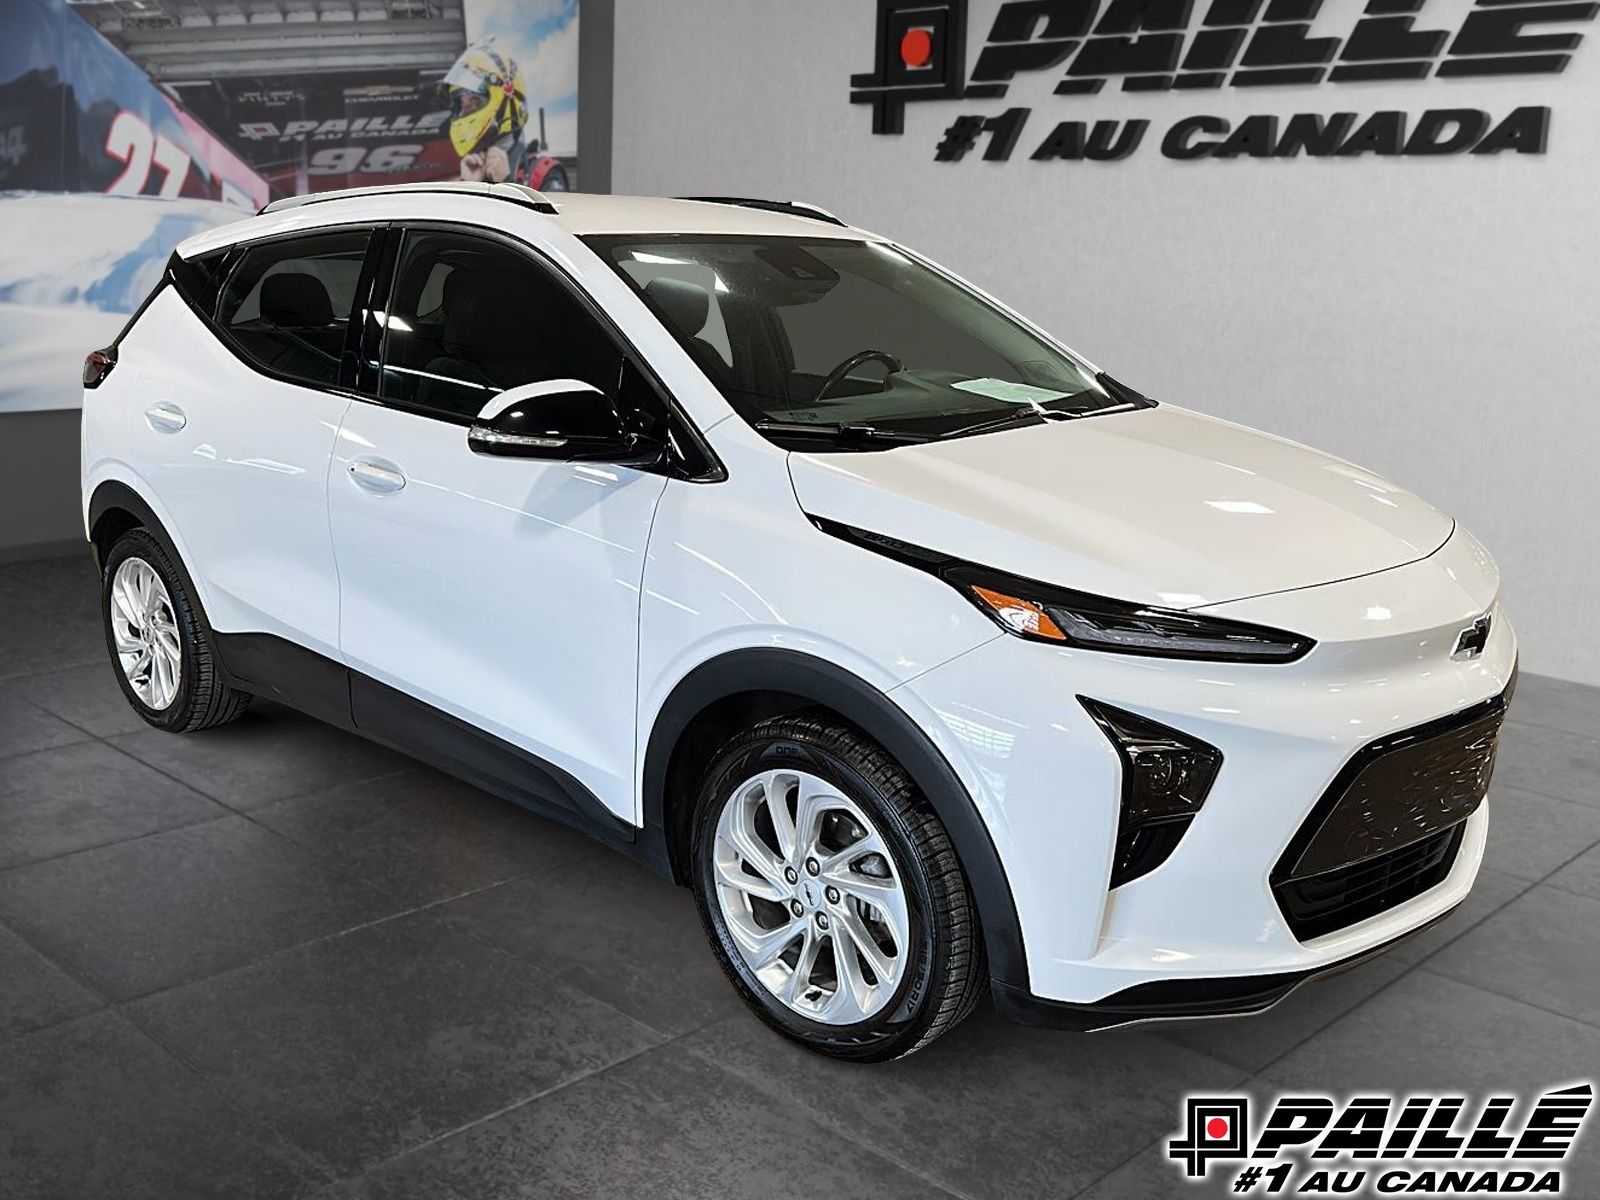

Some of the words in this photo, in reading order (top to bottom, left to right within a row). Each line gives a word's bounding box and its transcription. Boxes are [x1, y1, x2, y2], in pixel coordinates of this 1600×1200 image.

[105, 110, 190, 199] 27
[312, 133, 343, 141] AU
[350, 128, 440, 138] CANADA
[934, 107, 1033, 162] #1
[1029, 119, 1151, 161] AU
[1160, 106, 1552, 161] CANADA
[307, 144, 424, 175] 96
